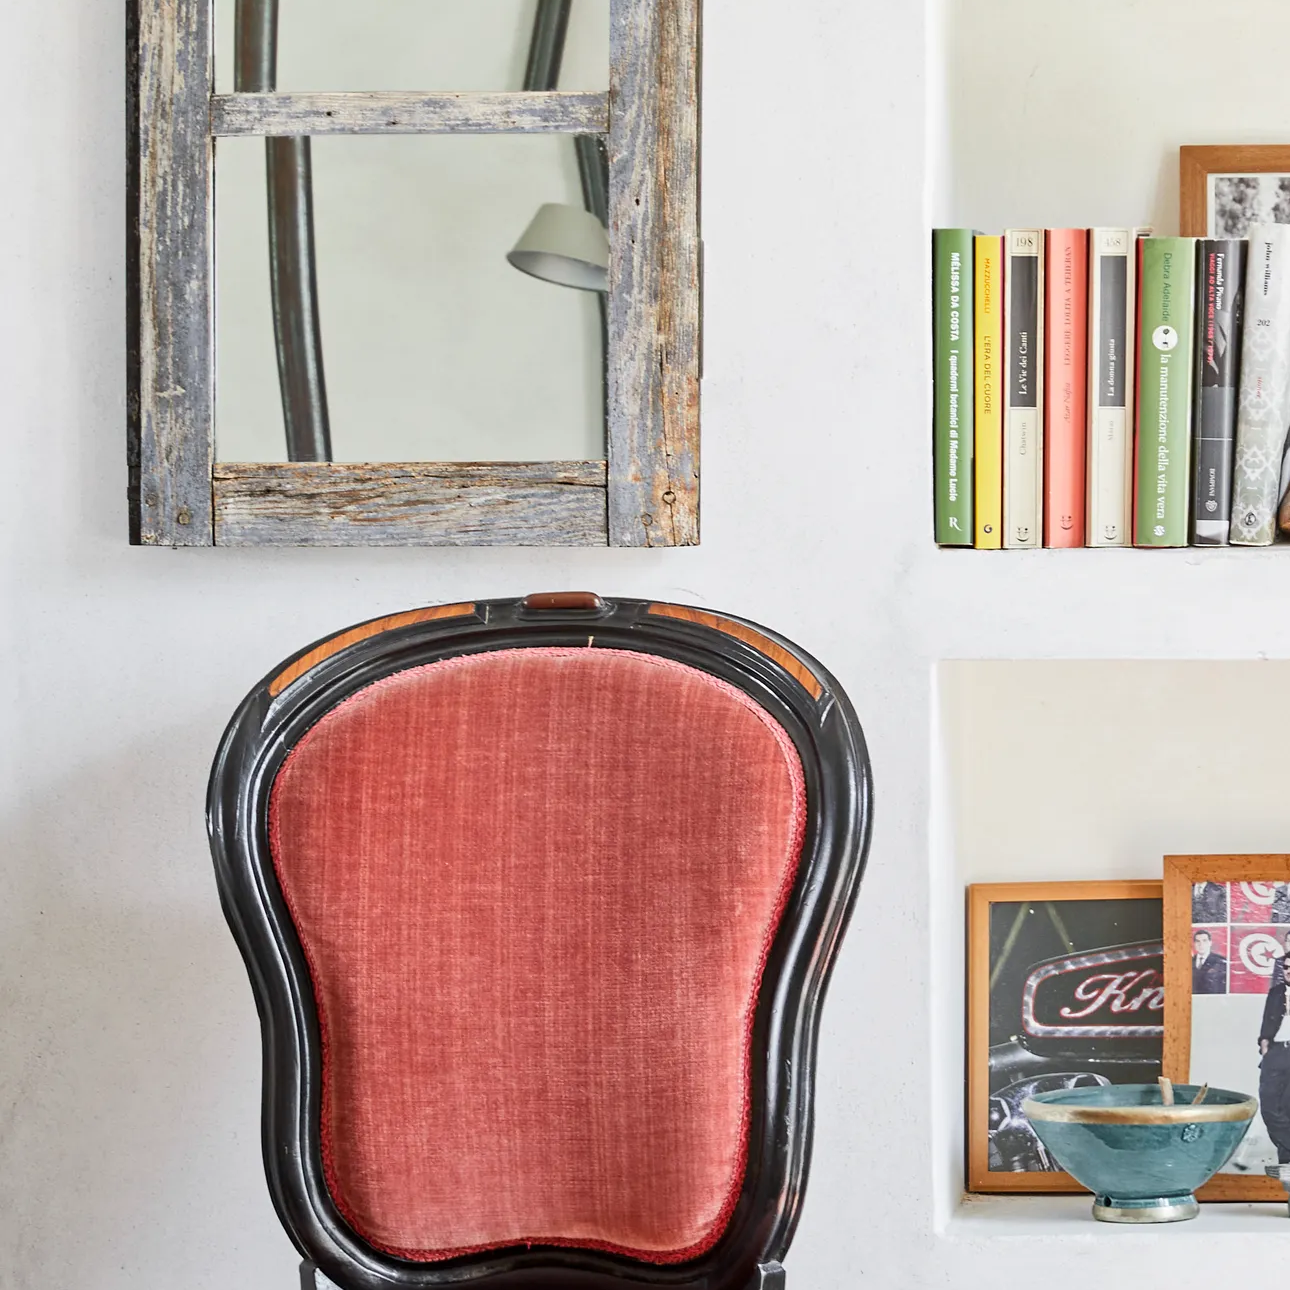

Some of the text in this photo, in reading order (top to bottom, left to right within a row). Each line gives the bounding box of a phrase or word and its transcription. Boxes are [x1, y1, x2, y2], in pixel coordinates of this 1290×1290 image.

[1016, 237, 1033, 247] 198
[1215, 253, 1224, 310] Fernanda Pivano
[1263, 242, 1273, 296] john williams
[950, 253, 962, 341] MÉLISSA DA COSTA
[1162, 253, 1172, 322] Debra Adelaide
[1064, 297, 1072, 325] LOLITA
[1256, 319, 1270, 327] 202
[949, 355, 959, 391] quaderni
[1018, 332, 1028, 394] Le Vie dei Canti
[1107, 339, 1116, 396] La donna giusta
[950, 394, 959, 427] botanici
[950, 430, 958, 438] di
[1019, 422, 1027, 455] Chatwin
[1156, 354, 1171, 518] la manutenzione della vita vera
[949, 440, 958, 476] Madame
[949, 479, 958, 501] Lucie
